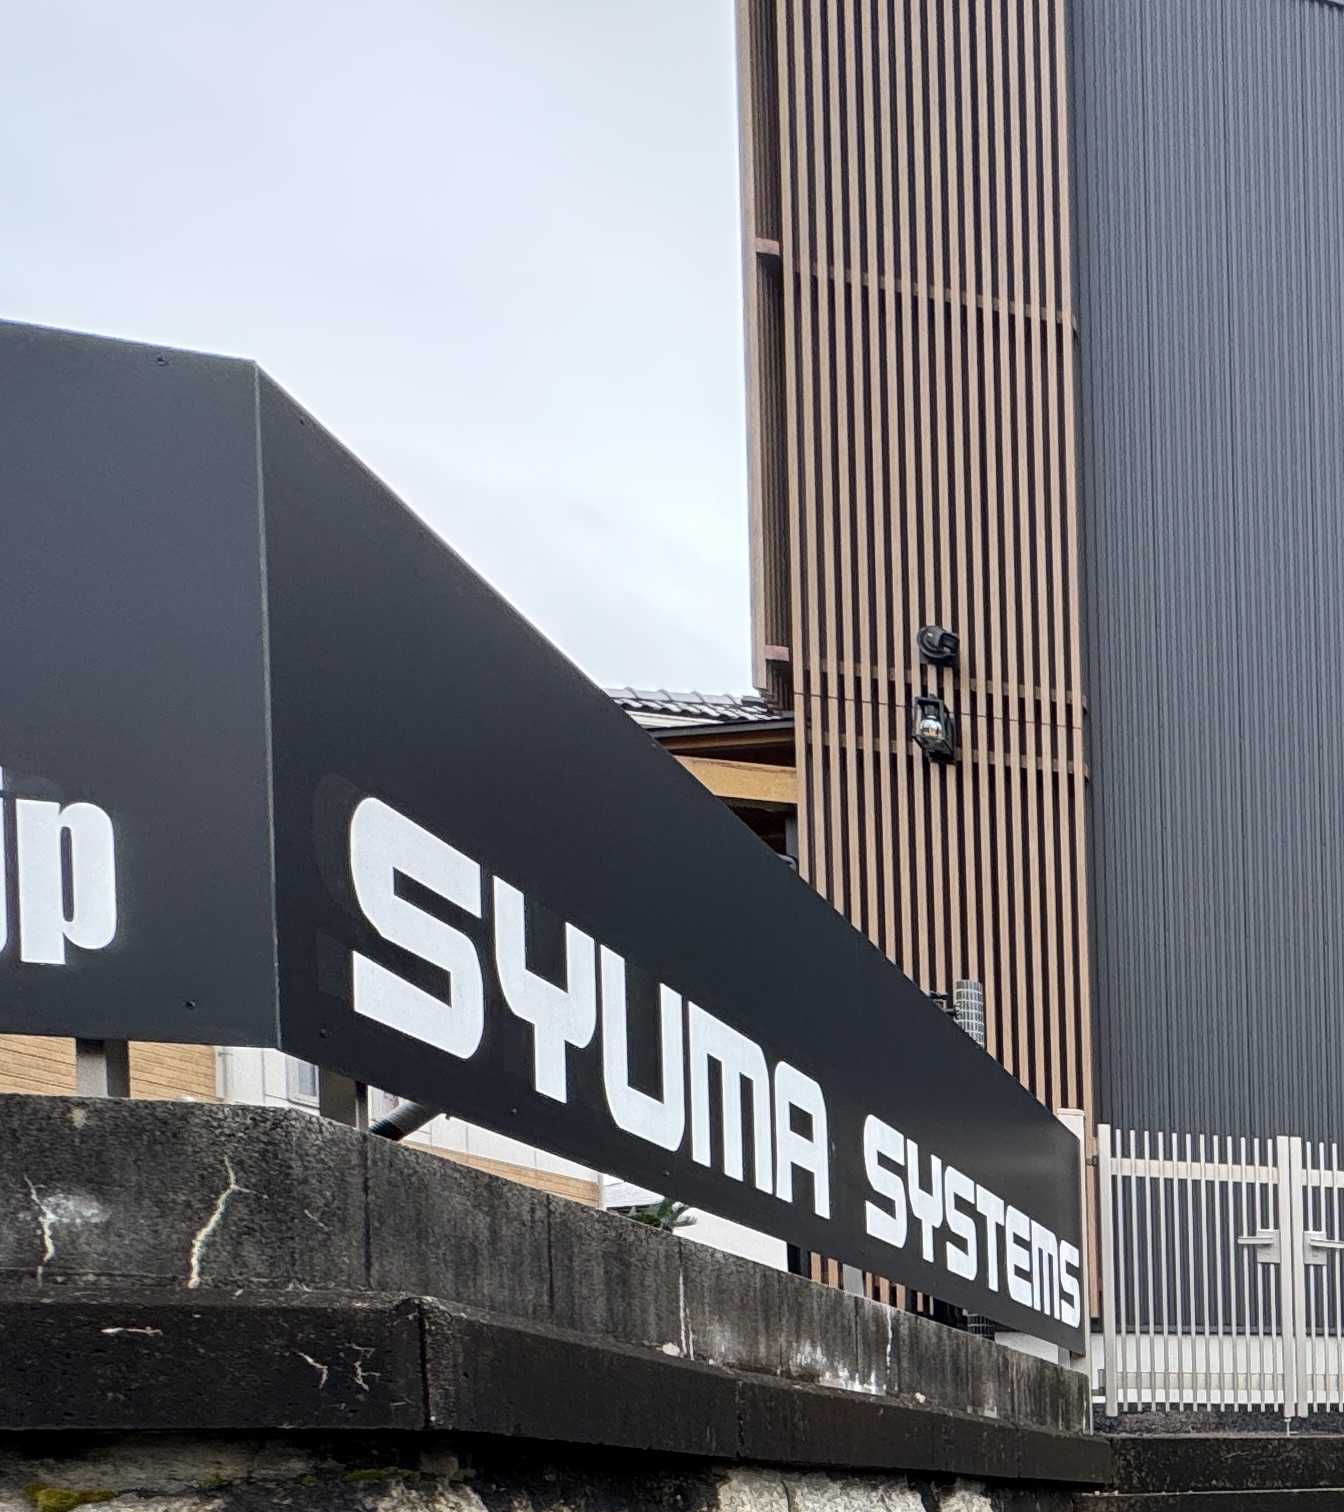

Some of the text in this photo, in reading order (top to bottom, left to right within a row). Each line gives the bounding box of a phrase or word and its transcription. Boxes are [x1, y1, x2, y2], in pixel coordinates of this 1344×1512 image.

[0, 766, 118, 965] p
[350, 796, 1082, 1330] SYUMA SYSTEMS
